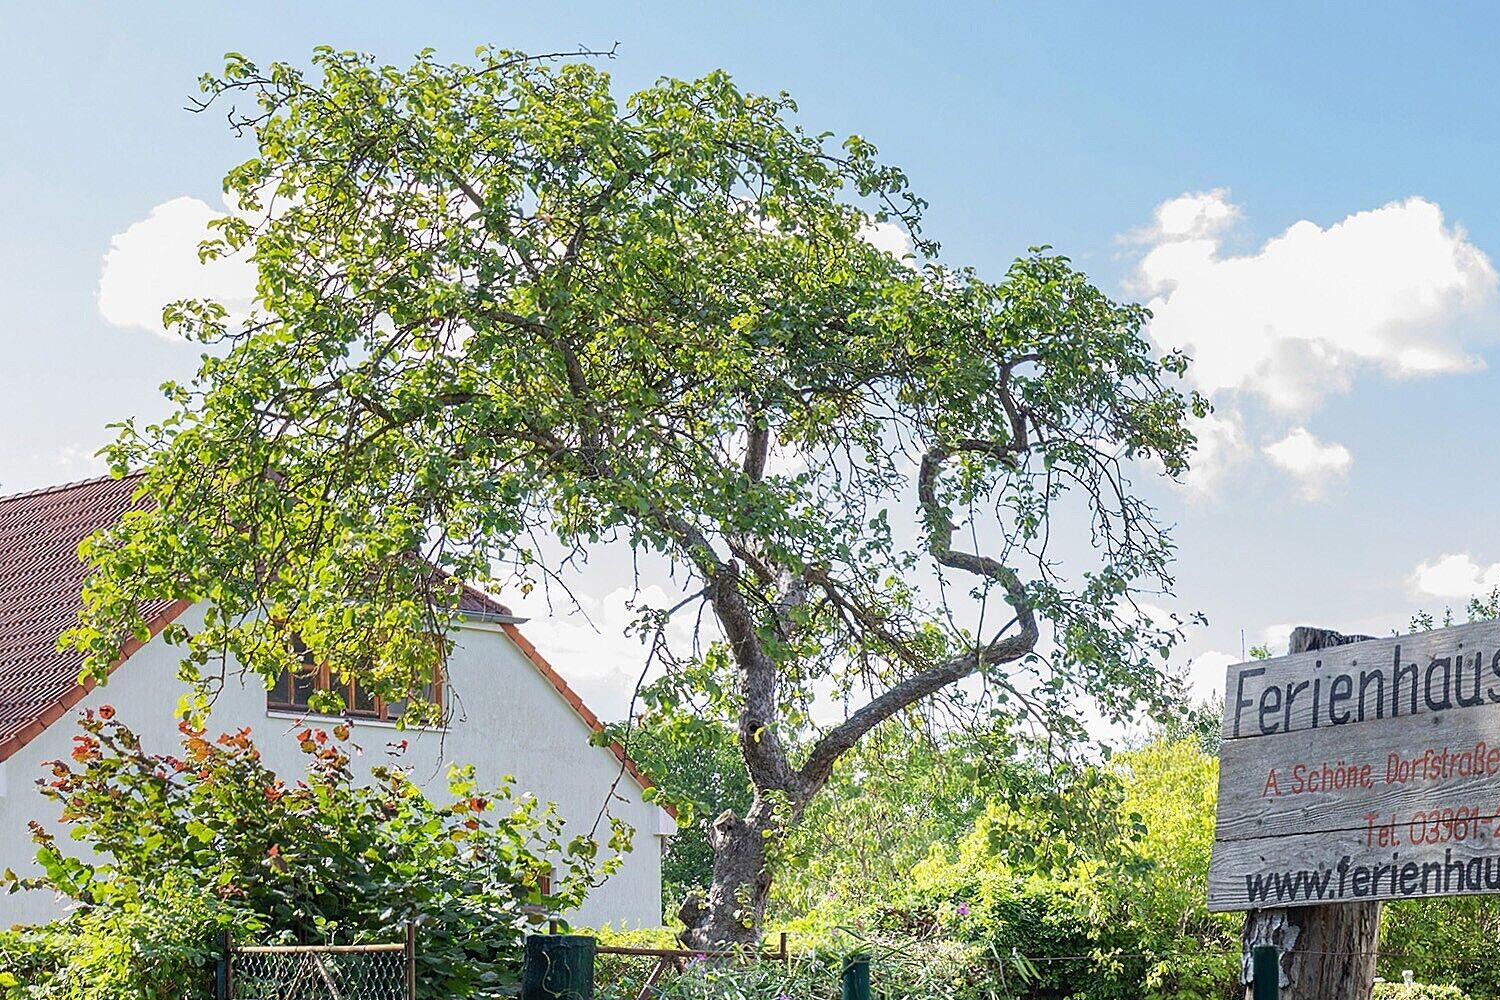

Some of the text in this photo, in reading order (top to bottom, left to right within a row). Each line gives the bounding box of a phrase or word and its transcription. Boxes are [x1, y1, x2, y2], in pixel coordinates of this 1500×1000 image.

[1291, 761, 1374, 795] Schöne,
[1386, 741, 1500, 785] Dorfstraße
[1363, 811, 1400, 848] Tel.
